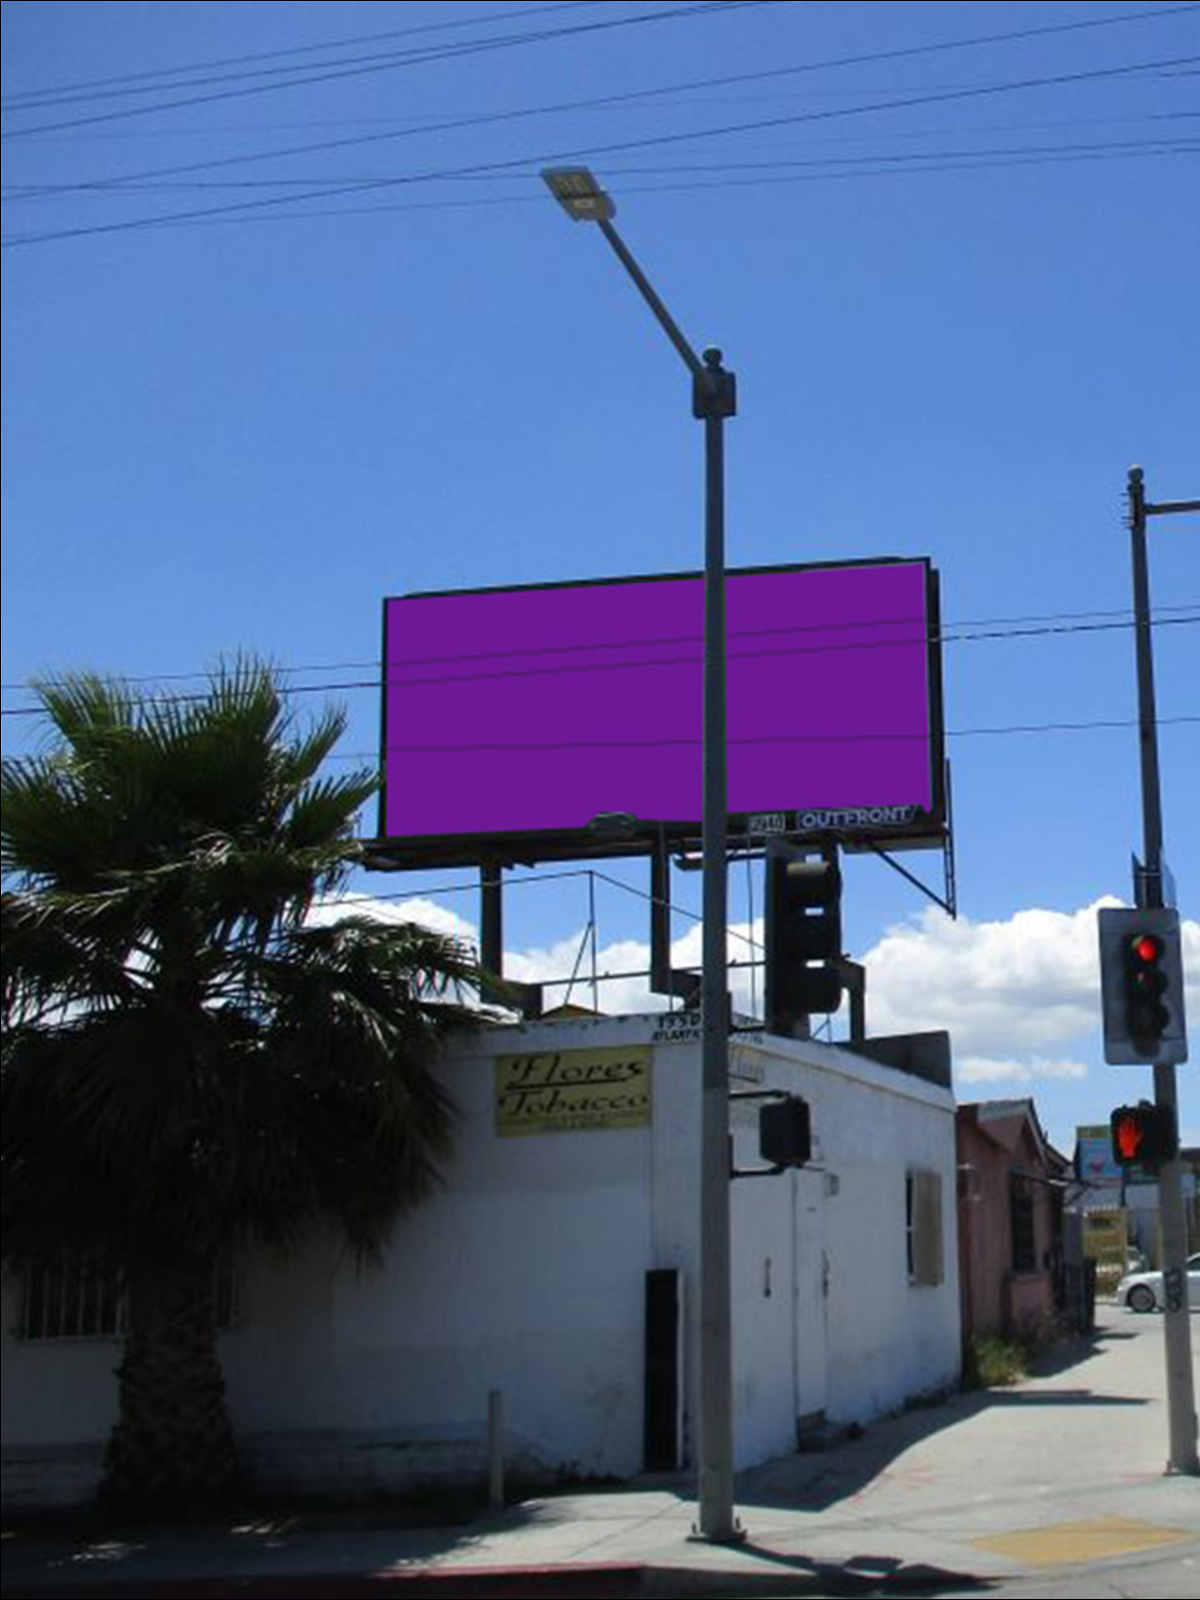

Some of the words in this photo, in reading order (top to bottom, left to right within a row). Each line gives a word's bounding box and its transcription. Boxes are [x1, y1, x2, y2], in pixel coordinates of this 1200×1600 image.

[801, 806, 910, 828] OUTFRONT
[510, 1055, 645, 1084] Flores
[497, 1089, 649, 1117] Tobacco
